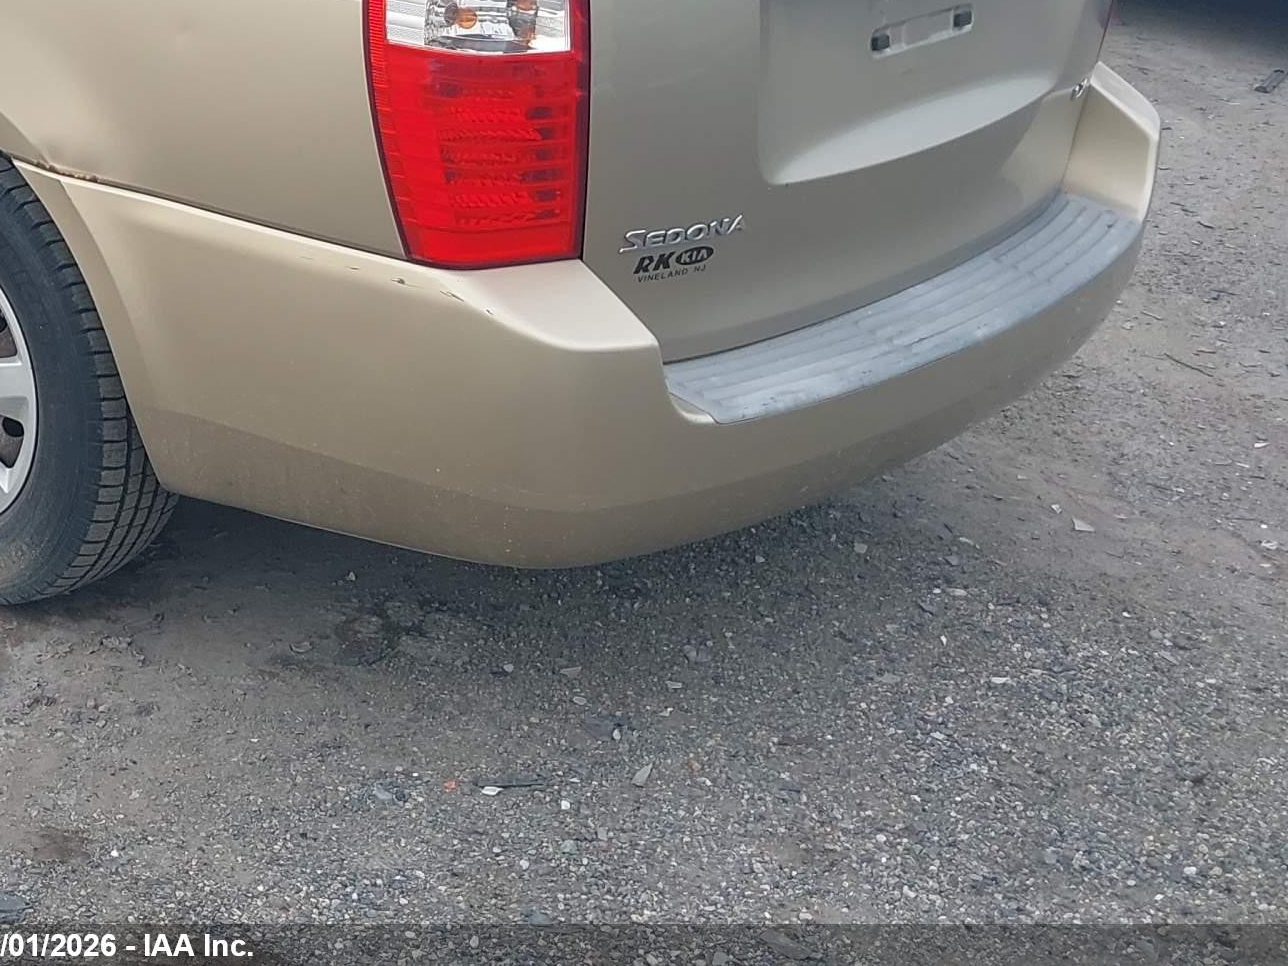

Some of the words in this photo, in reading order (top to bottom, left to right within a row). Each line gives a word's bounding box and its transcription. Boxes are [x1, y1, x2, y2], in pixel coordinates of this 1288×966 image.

[618, 214, 744, 253] SEDONA
[633, 251, 675, 275] RK
[678, 248, 711, 265] KIA
[637, 268, 689, 283] VINELAND
[694, 264, 707, 273] NJ
